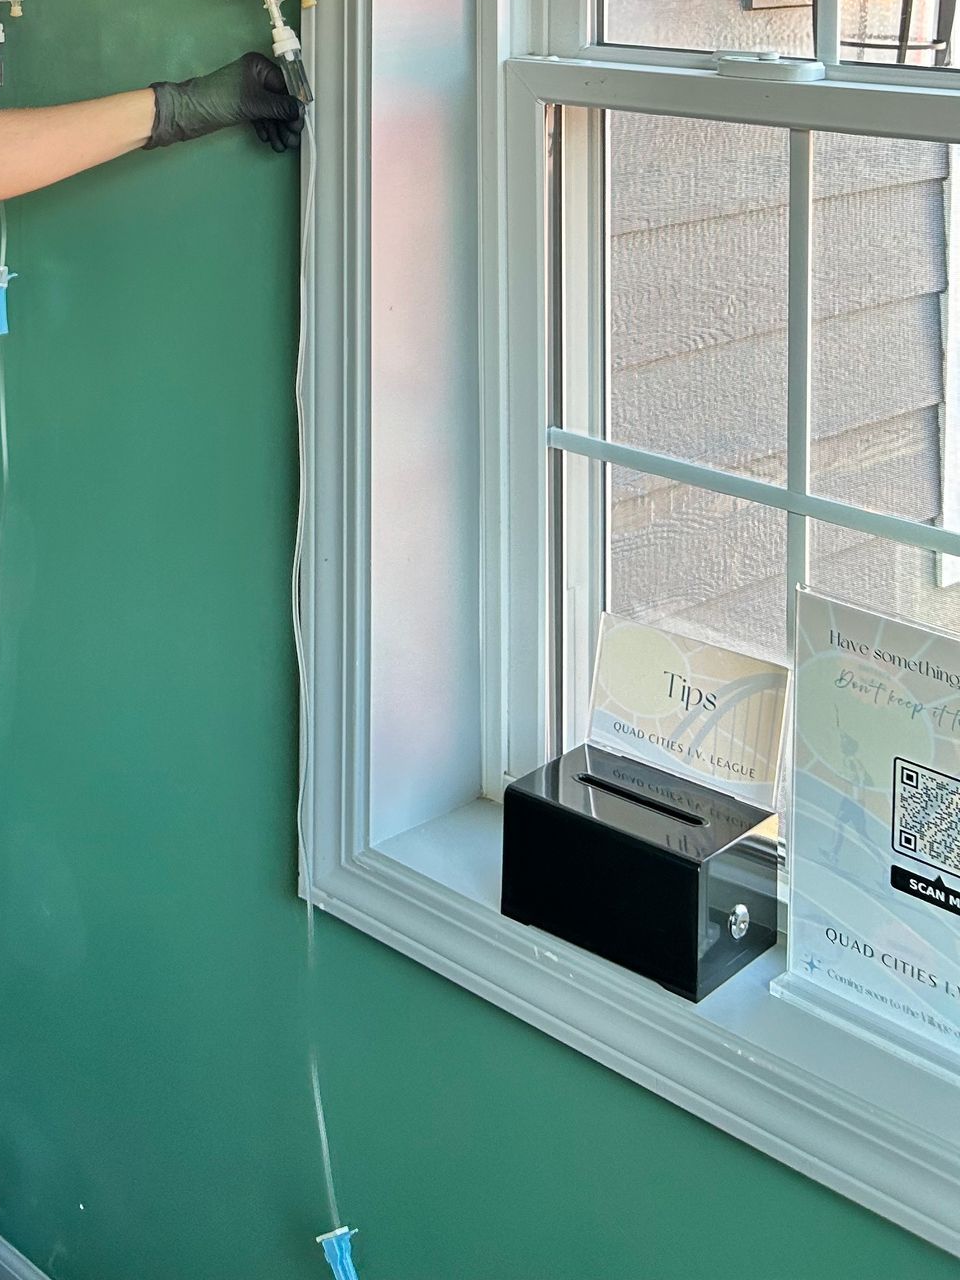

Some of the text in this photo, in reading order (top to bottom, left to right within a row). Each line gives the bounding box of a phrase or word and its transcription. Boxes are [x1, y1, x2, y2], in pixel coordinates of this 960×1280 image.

[829, 628, 869, 656] Have
[663, 670, 718, 712] Tips
[833, 668, 887, 705] Don't
[886, 689, 927, 721] keep
[613, 721, 758, 780] QUAD CITIES I.V. LEAGUE
[909, 878, 960, 910] SCAN M
[825, 927, 875, 959] QUAD
[881, 952, 938, 989] CITIES
[826, 967, 864, 995] Coming
